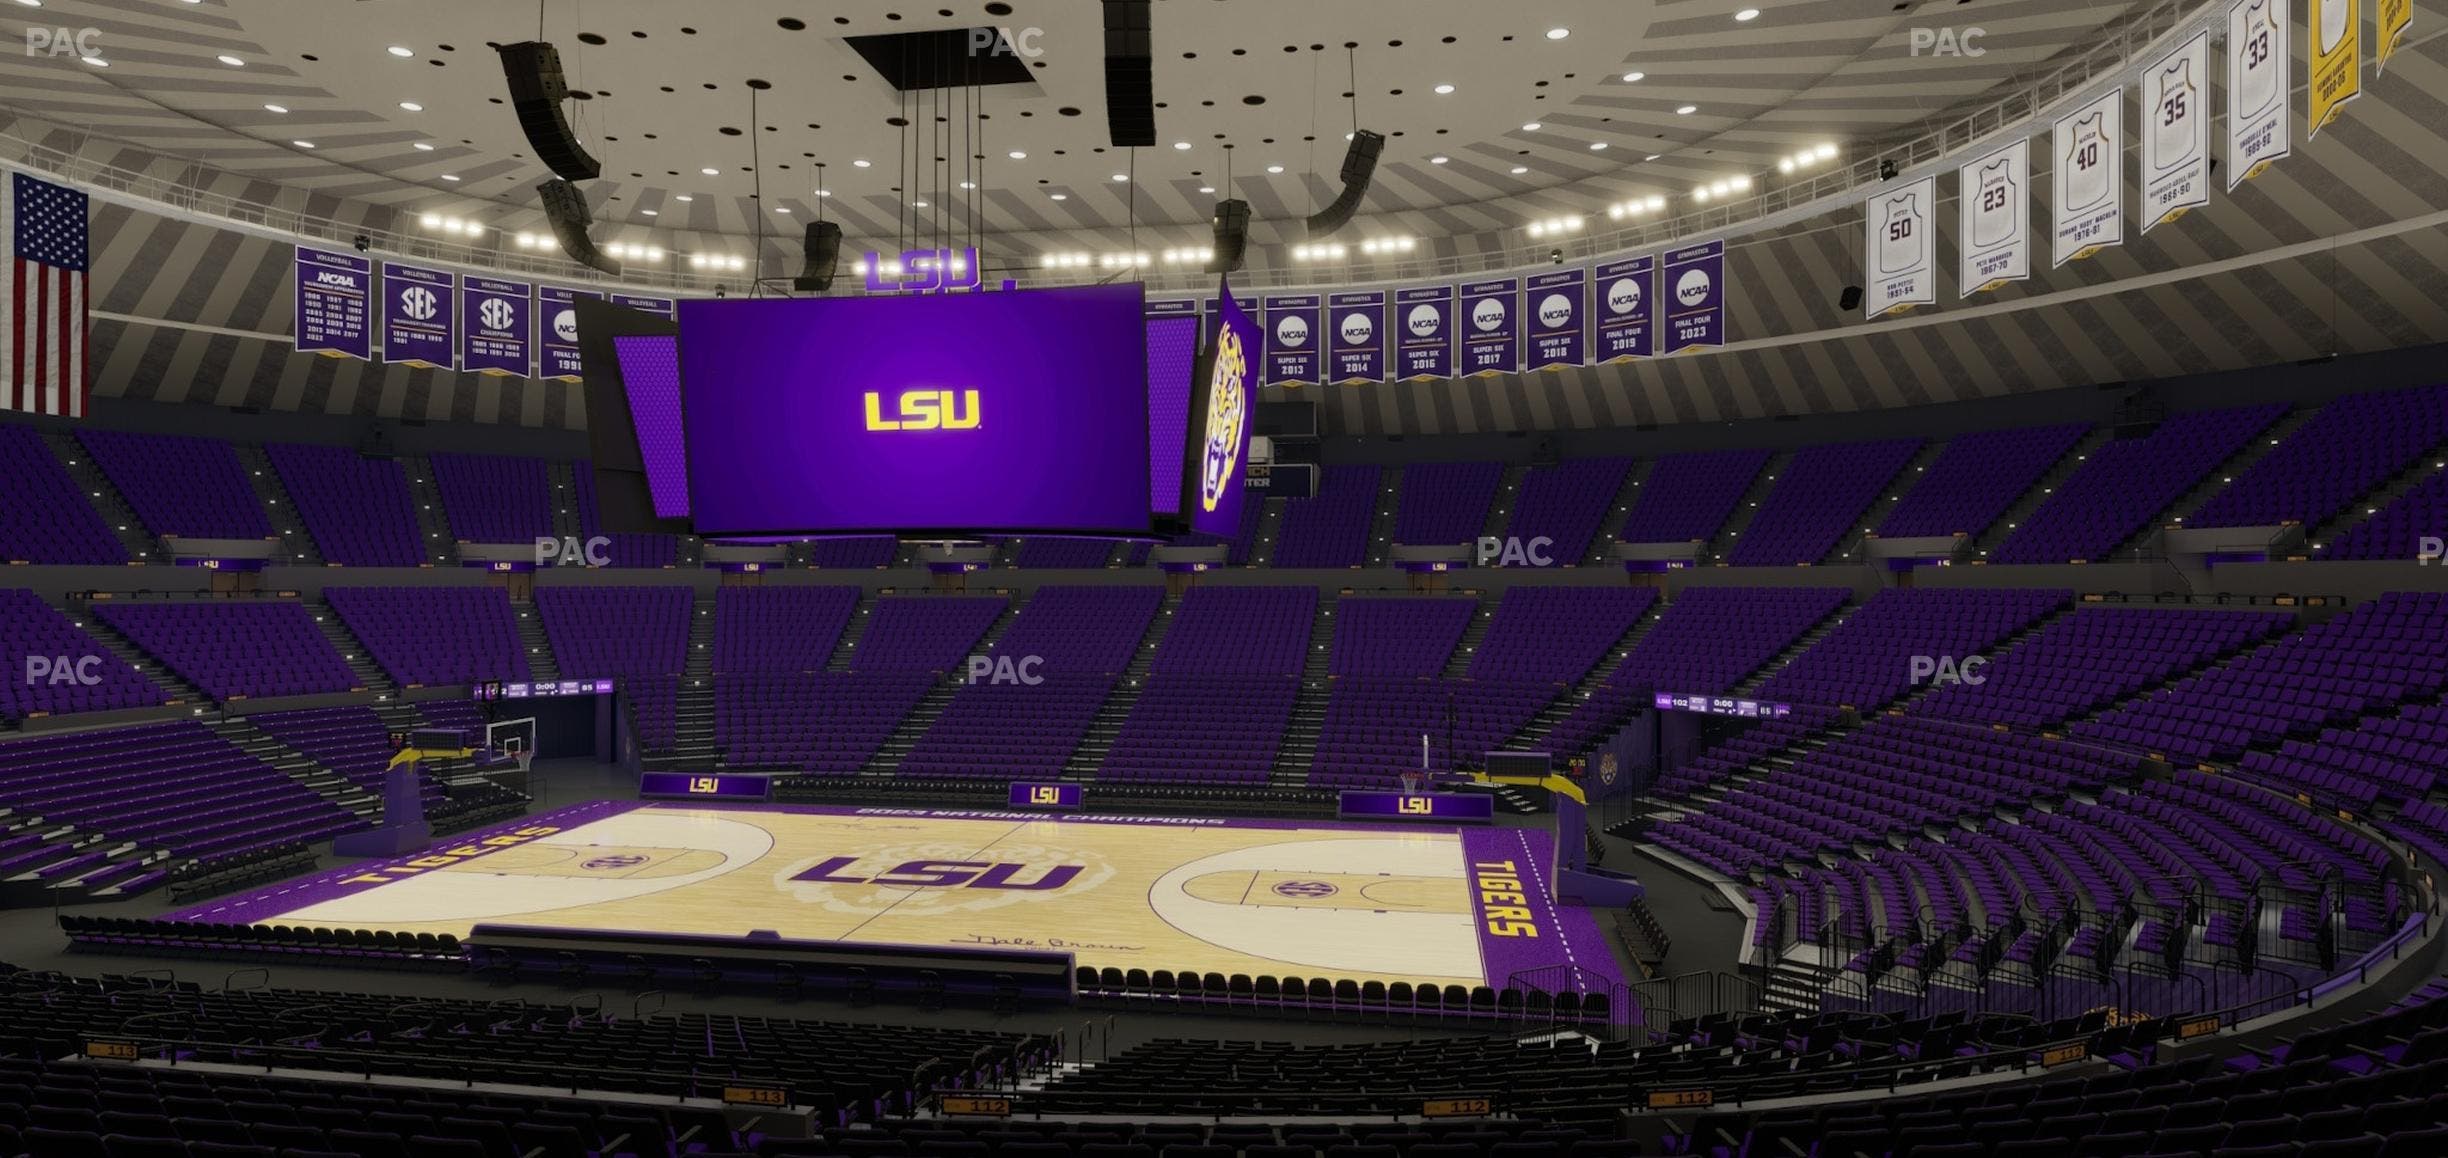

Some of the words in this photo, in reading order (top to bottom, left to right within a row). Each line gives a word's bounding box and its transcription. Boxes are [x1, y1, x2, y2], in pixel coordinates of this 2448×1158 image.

[2249, 30, 2268, 70] 33
[2164, 91, 2185, 127] 35
[2077, 142, 2097, 171] 40
[1984, 185, 2005, 213] 23
[1890, 218, 1911, 241] 50
[316, 253, 352, 266] VOLLEYBALL
[864, 247, 981, 291] LSU
[318, 271, 355, 287] NCAA
[1680, 285, 1708, 298] NCAA
[401, 286, 437, 320] SEC
[1611, 293, 1640, 306] NCAA
[480, 298, 514, 330] SEC
[1476, 313, 1503, 323] NCAA
[1542, 309, 1569, 320] NCAA
[1412, 319, 1438, 329] NCAA
[1675, 319, 1692, 328] FINAL
[1694, 315, 1711, 325] FOUR
[558, 324, 577, 333] NC
[1281, 331, 1306, 339] NCAA
[1344, 327, 1371, 336] NCAA
[1606, 331, 1623, 339] FINAL
[1625, 327, 1642, 336] FOUR
[1680, 326, 1706, 340] 2023
[1539, 339, 1560, 347] SUPER
[1561, 337, 1571, 345] SIX
[1612, 337, 1636, 350] 2019
[553, 350, 572, 359] FINAL
[572, 352, 581, 360] FO
[1543, 347, 1567, 358] 2018
[1412, 359, 1436, 369] 2016
[1477, 354, 1500, 365] 2017
[1281, 365, 1304, 375] 2013
[1345, 363, 1368, 373] 2014
[864, 390, 981, 431] LSU
[495, 562, 512, 571] LSU
[744, 563, 759, 571] LSU
[1432, 563, 1447, 571] LSU
[1672, 699, 1688, 707] 102
[1714, 699, 1733, 708] 0:00
[689, 777, 719, 793] LSU
[1031, 786, 1059, 804] LSU
[1398, 796, 1433, 815] LSU
[855, 808, 927, 816] 2023
[931, 810, 1054, 820] NATIONAL
[1062, 814, 1226, 825] CHAMPIONS
[337, 826, 561, 885] TIGERS
[787, 856, 1086, 890] LSU
[1475, 860, 1538, 938] TIGERS
[108, 1046, 134, 1057] 113
[750, 1091, 781, 1103] 113
[1675, 1092, 1707, 1105] 112
[970, 1101, 1005, 1112] 112
[1450, 1101, 1485, 1113] 112
